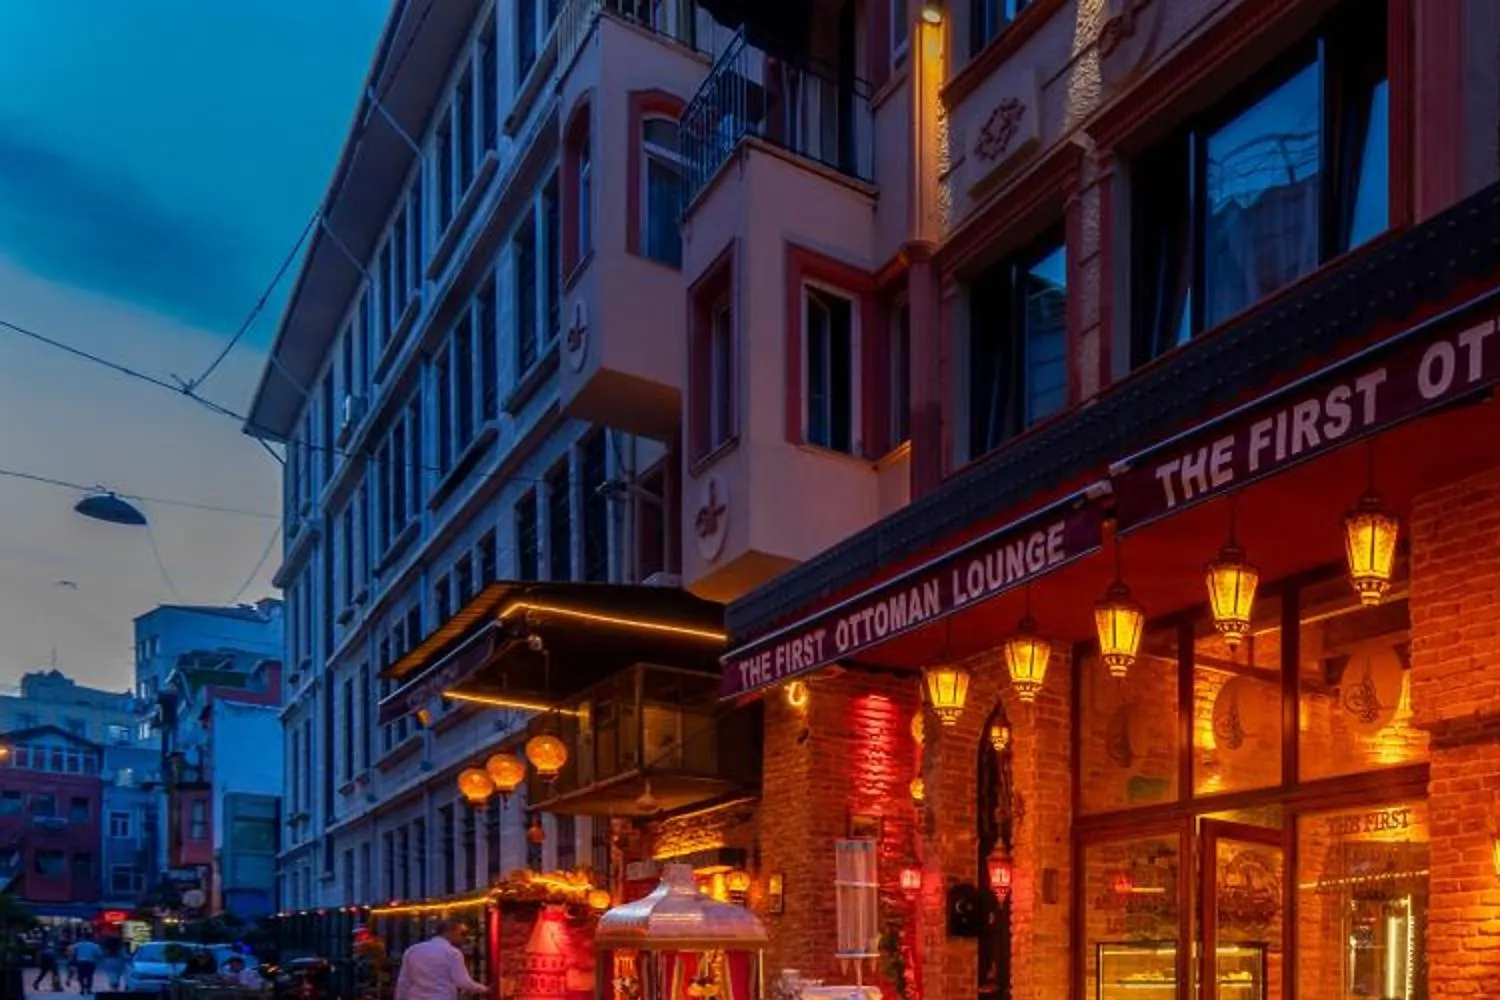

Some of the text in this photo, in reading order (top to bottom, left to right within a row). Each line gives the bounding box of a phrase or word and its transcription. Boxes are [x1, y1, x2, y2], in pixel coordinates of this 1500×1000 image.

[1155, 434, 1236, 509] THE
[1248, 367, 1387, 473] FIRST
[739, 521, 1066, 689] THE FIRST OTTOMAN LOUNGE
[1364, 808, 1411, 833] FIRST
